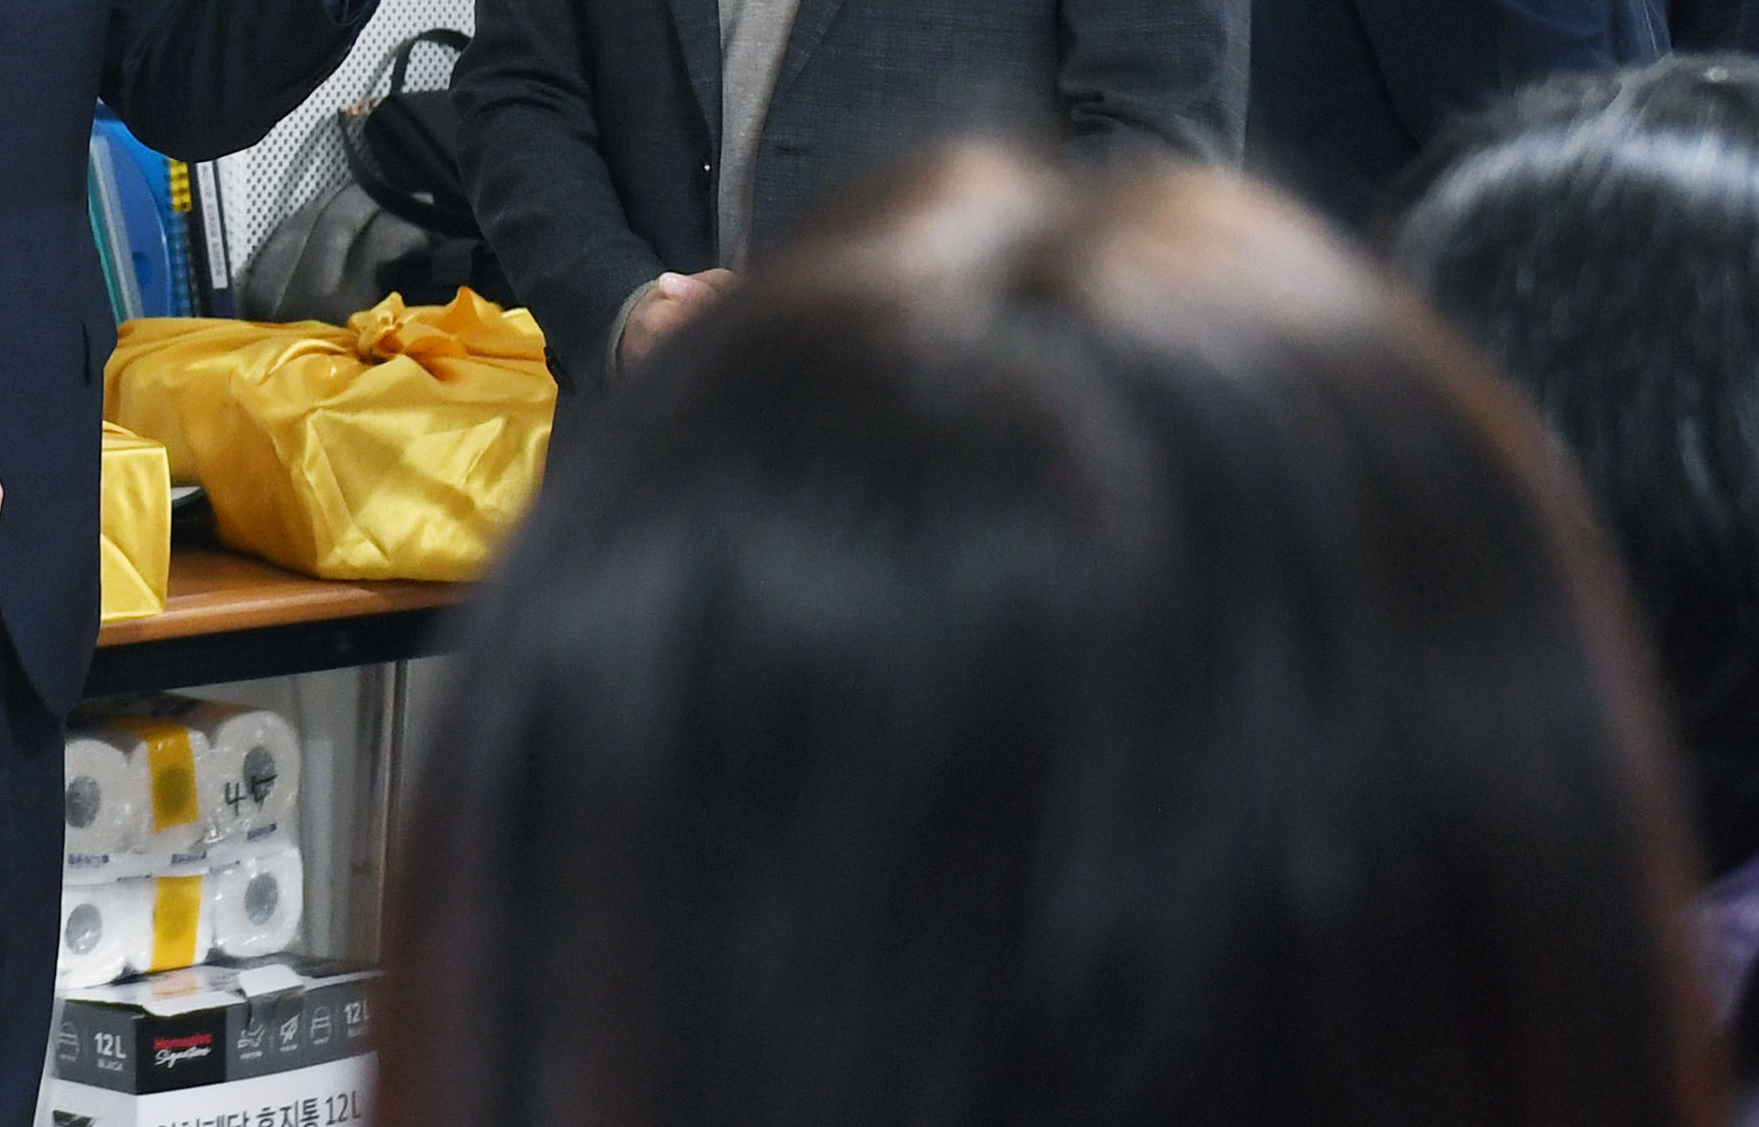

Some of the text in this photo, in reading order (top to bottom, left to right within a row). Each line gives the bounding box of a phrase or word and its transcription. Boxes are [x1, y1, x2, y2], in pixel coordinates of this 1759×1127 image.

[94, 1032, 127, 1060] 12L
[97, 1058, 124, 1071] BLACK
[325, 1090, 363, 1125] 12L
